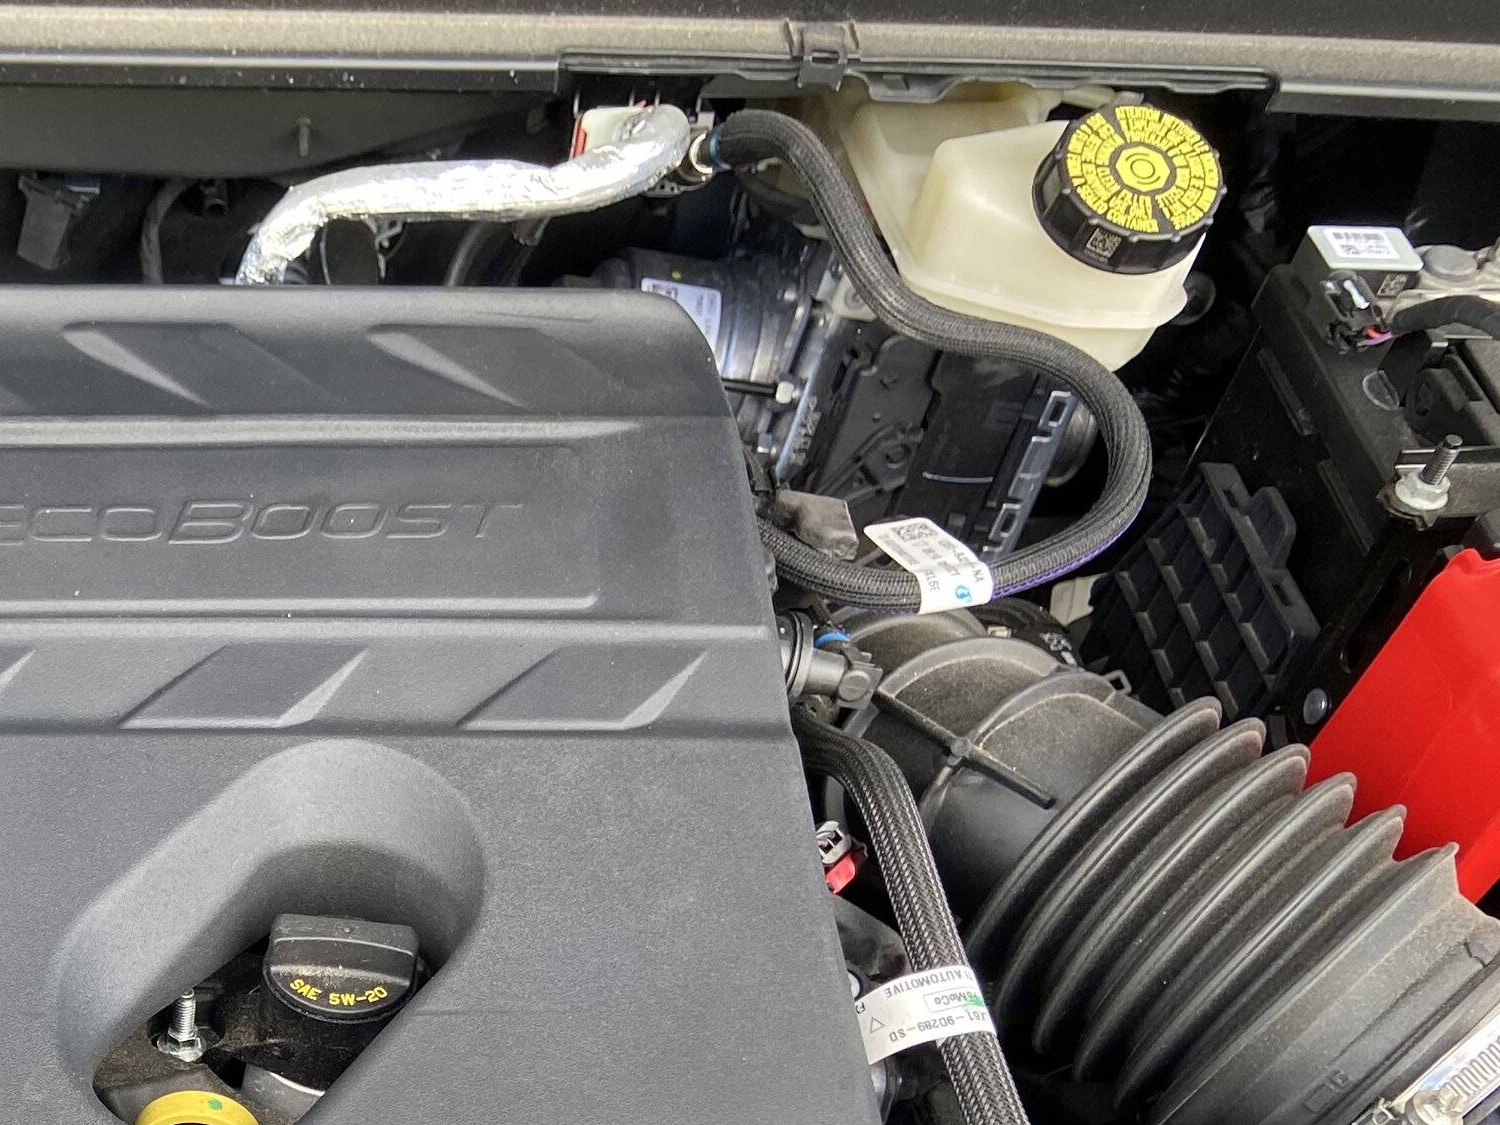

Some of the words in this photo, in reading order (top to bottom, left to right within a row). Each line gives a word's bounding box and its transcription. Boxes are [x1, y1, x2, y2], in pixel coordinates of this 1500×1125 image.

[290, 979, 322, 1001] SAE
[329, 986, 388, 1006] 5W-20
[884, 969, 962, 998] AUTOMOTIVE
